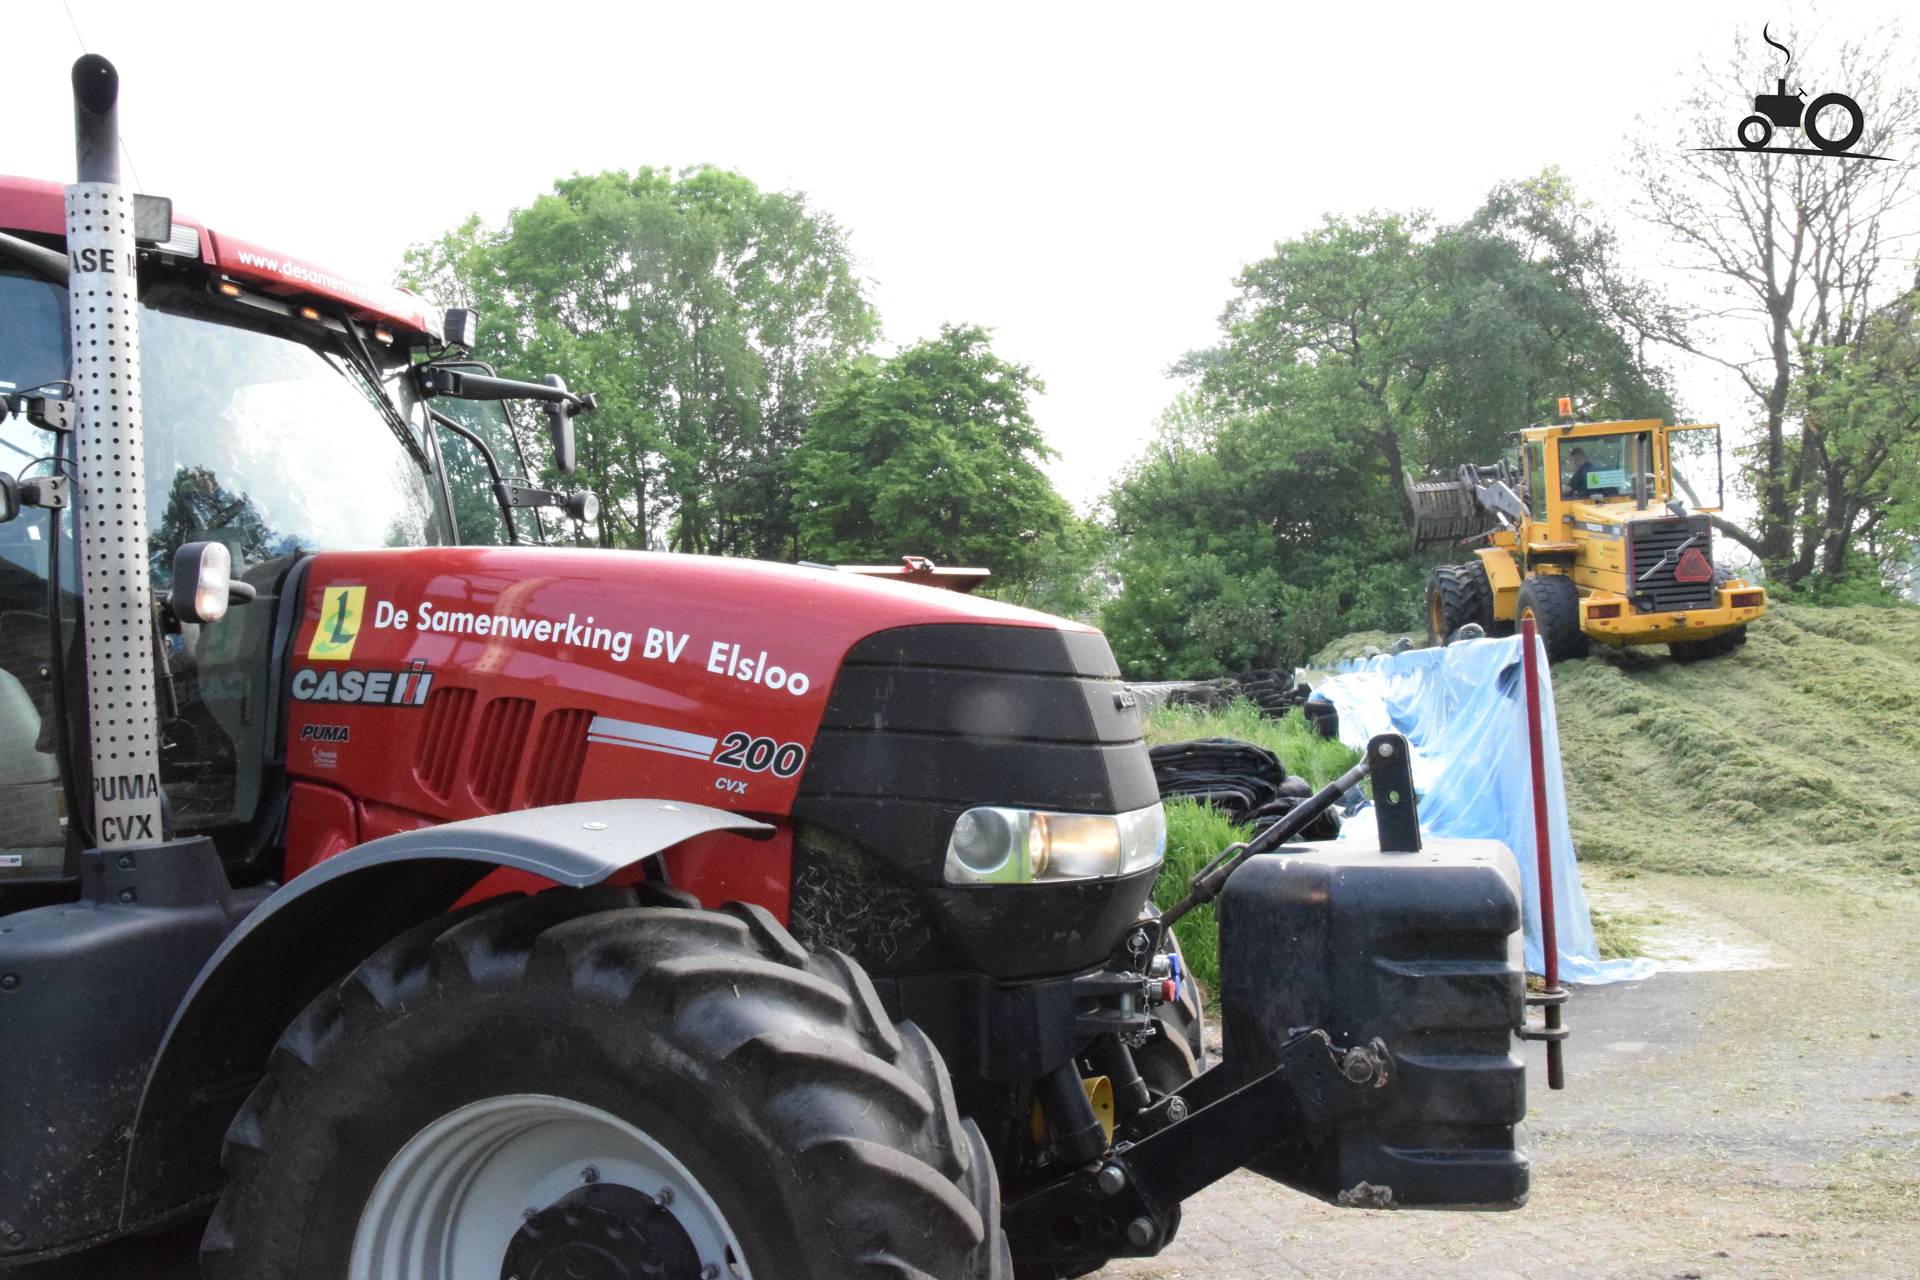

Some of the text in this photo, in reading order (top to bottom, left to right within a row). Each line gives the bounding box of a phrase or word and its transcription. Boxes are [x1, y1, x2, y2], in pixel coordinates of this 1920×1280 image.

[374, 600, 810, 696] De Samenwerking BV Elsloo
[291, 668, 391, 703] CASE
[301, 724, 350, 742] PUMA
[713, 731, 806, 779] 200
[714, 776, 749, 795] CVX
[102, 814, 153, 843] CVX
